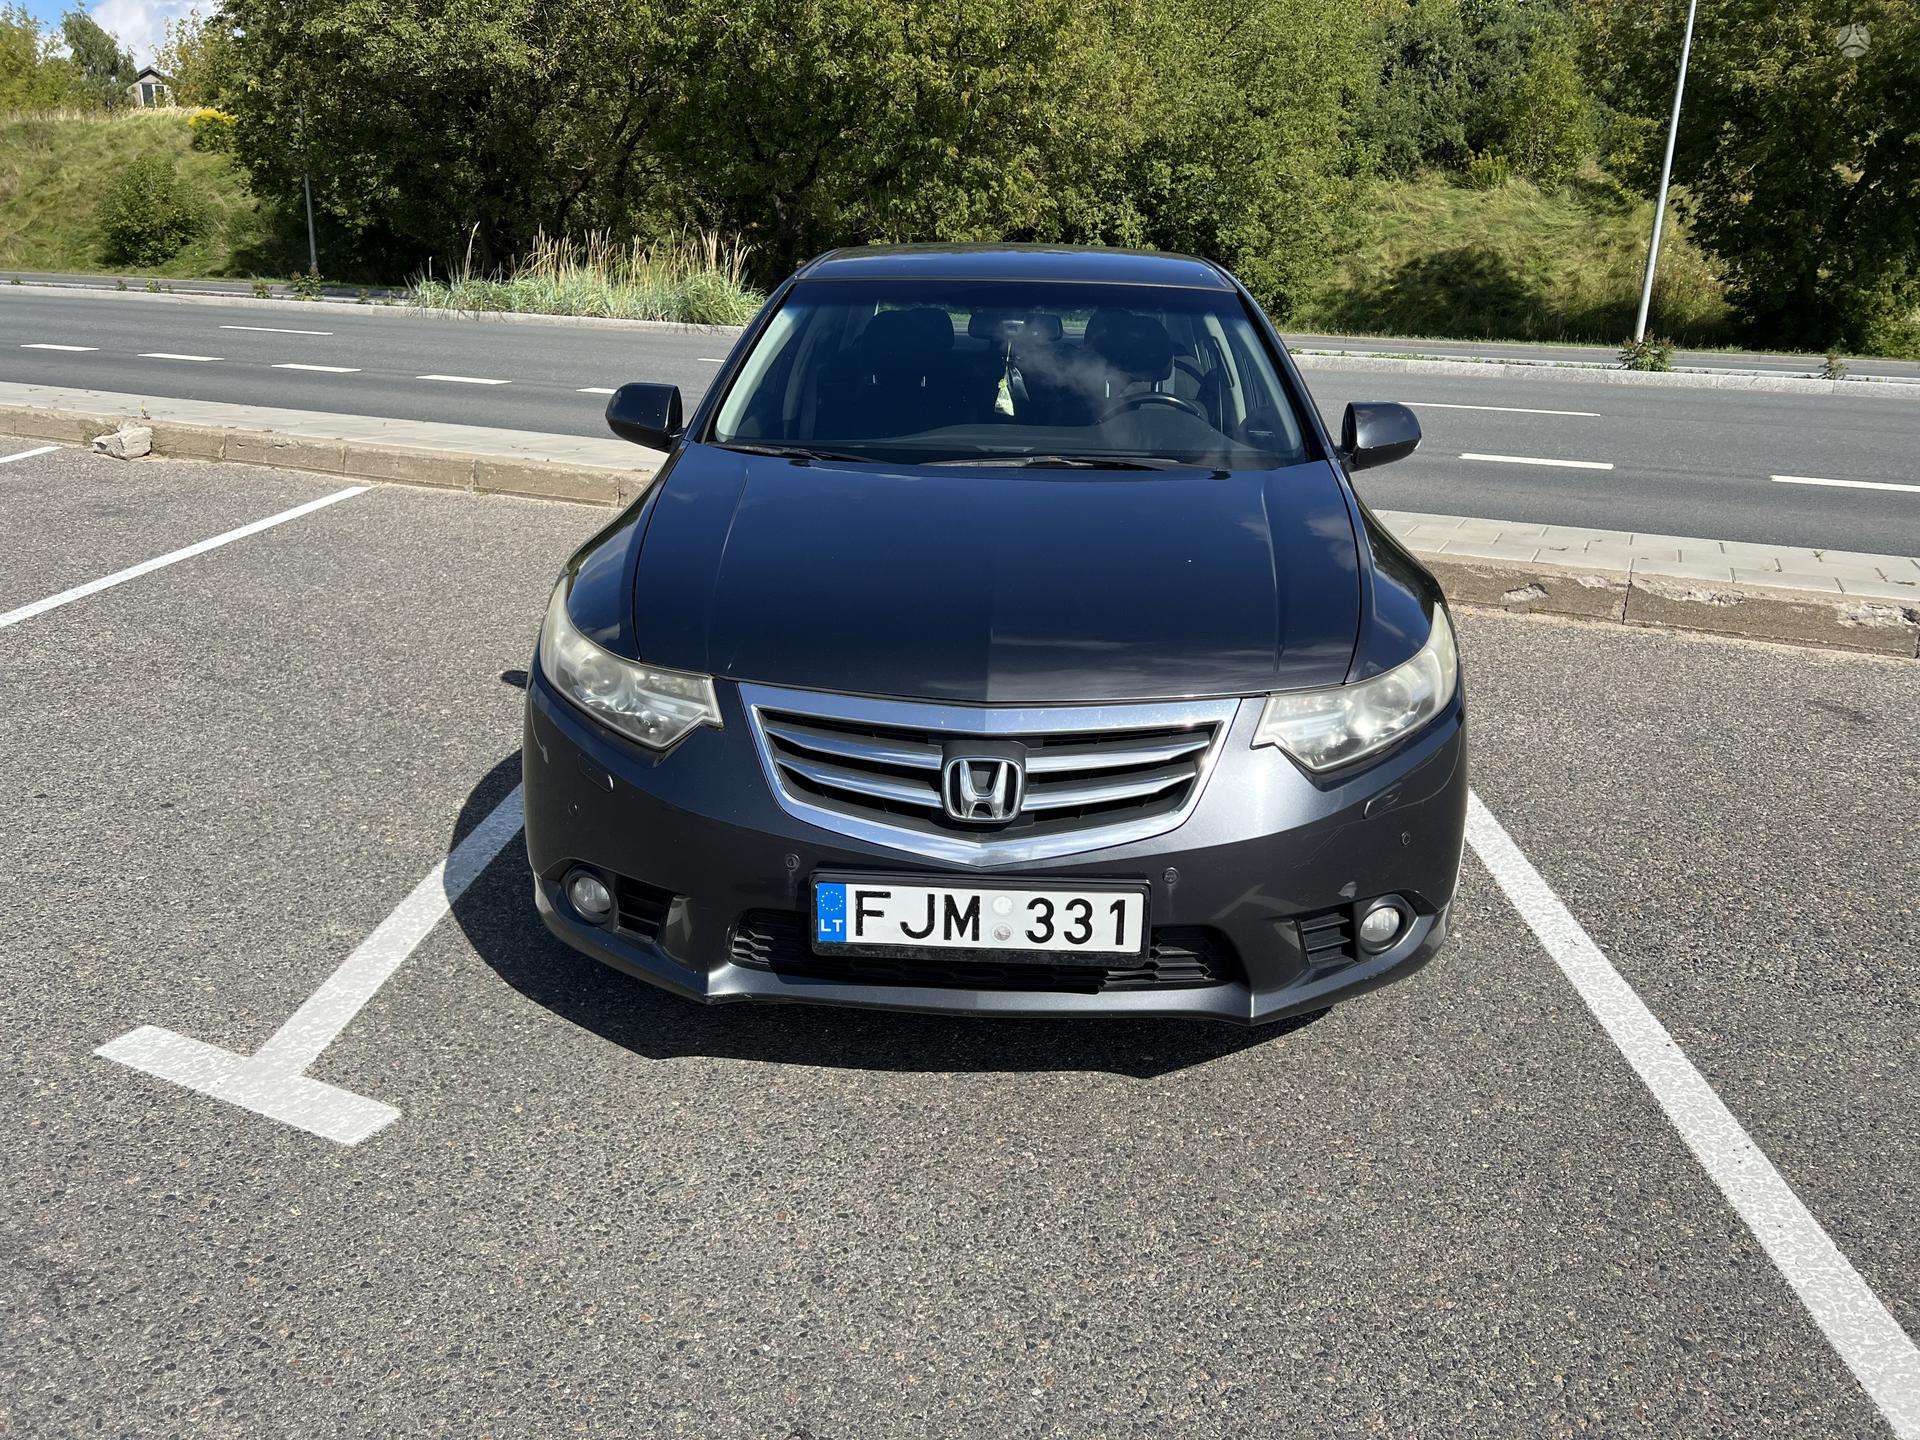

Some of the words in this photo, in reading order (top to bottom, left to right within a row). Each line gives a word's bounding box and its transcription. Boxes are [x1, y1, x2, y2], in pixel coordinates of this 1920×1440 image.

[820, 918, 843, 932] LT
[855, 890, 981, 941] FJM
[1025, 897, 1127, 946] 331
